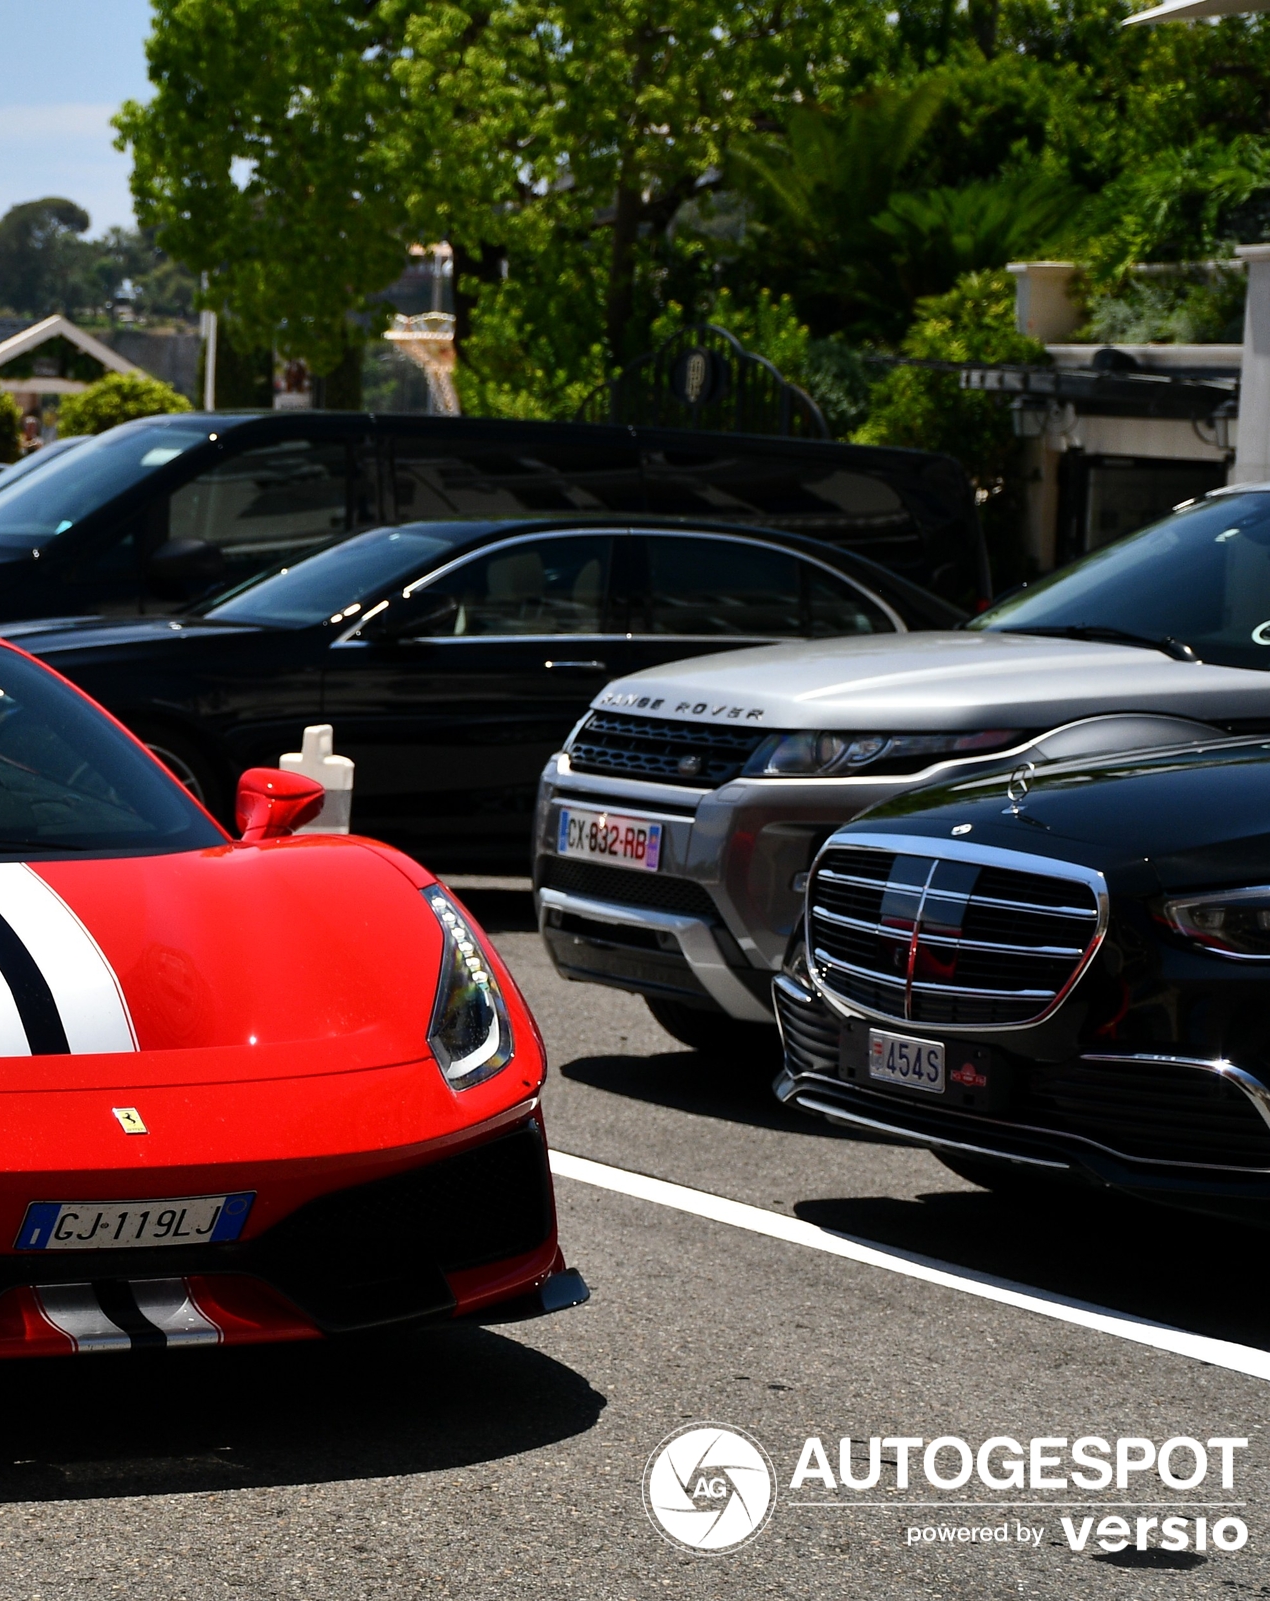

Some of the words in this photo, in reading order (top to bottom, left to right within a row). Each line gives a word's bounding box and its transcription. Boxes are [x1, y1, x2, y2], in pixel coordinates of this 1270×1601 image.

[601, 692, 665, 709] RANGE
[675, 702, 764, 721] ROVER
[568, 819, 647, 860] CX-832-RB
[887, 1042, 939, 1083] 454S
